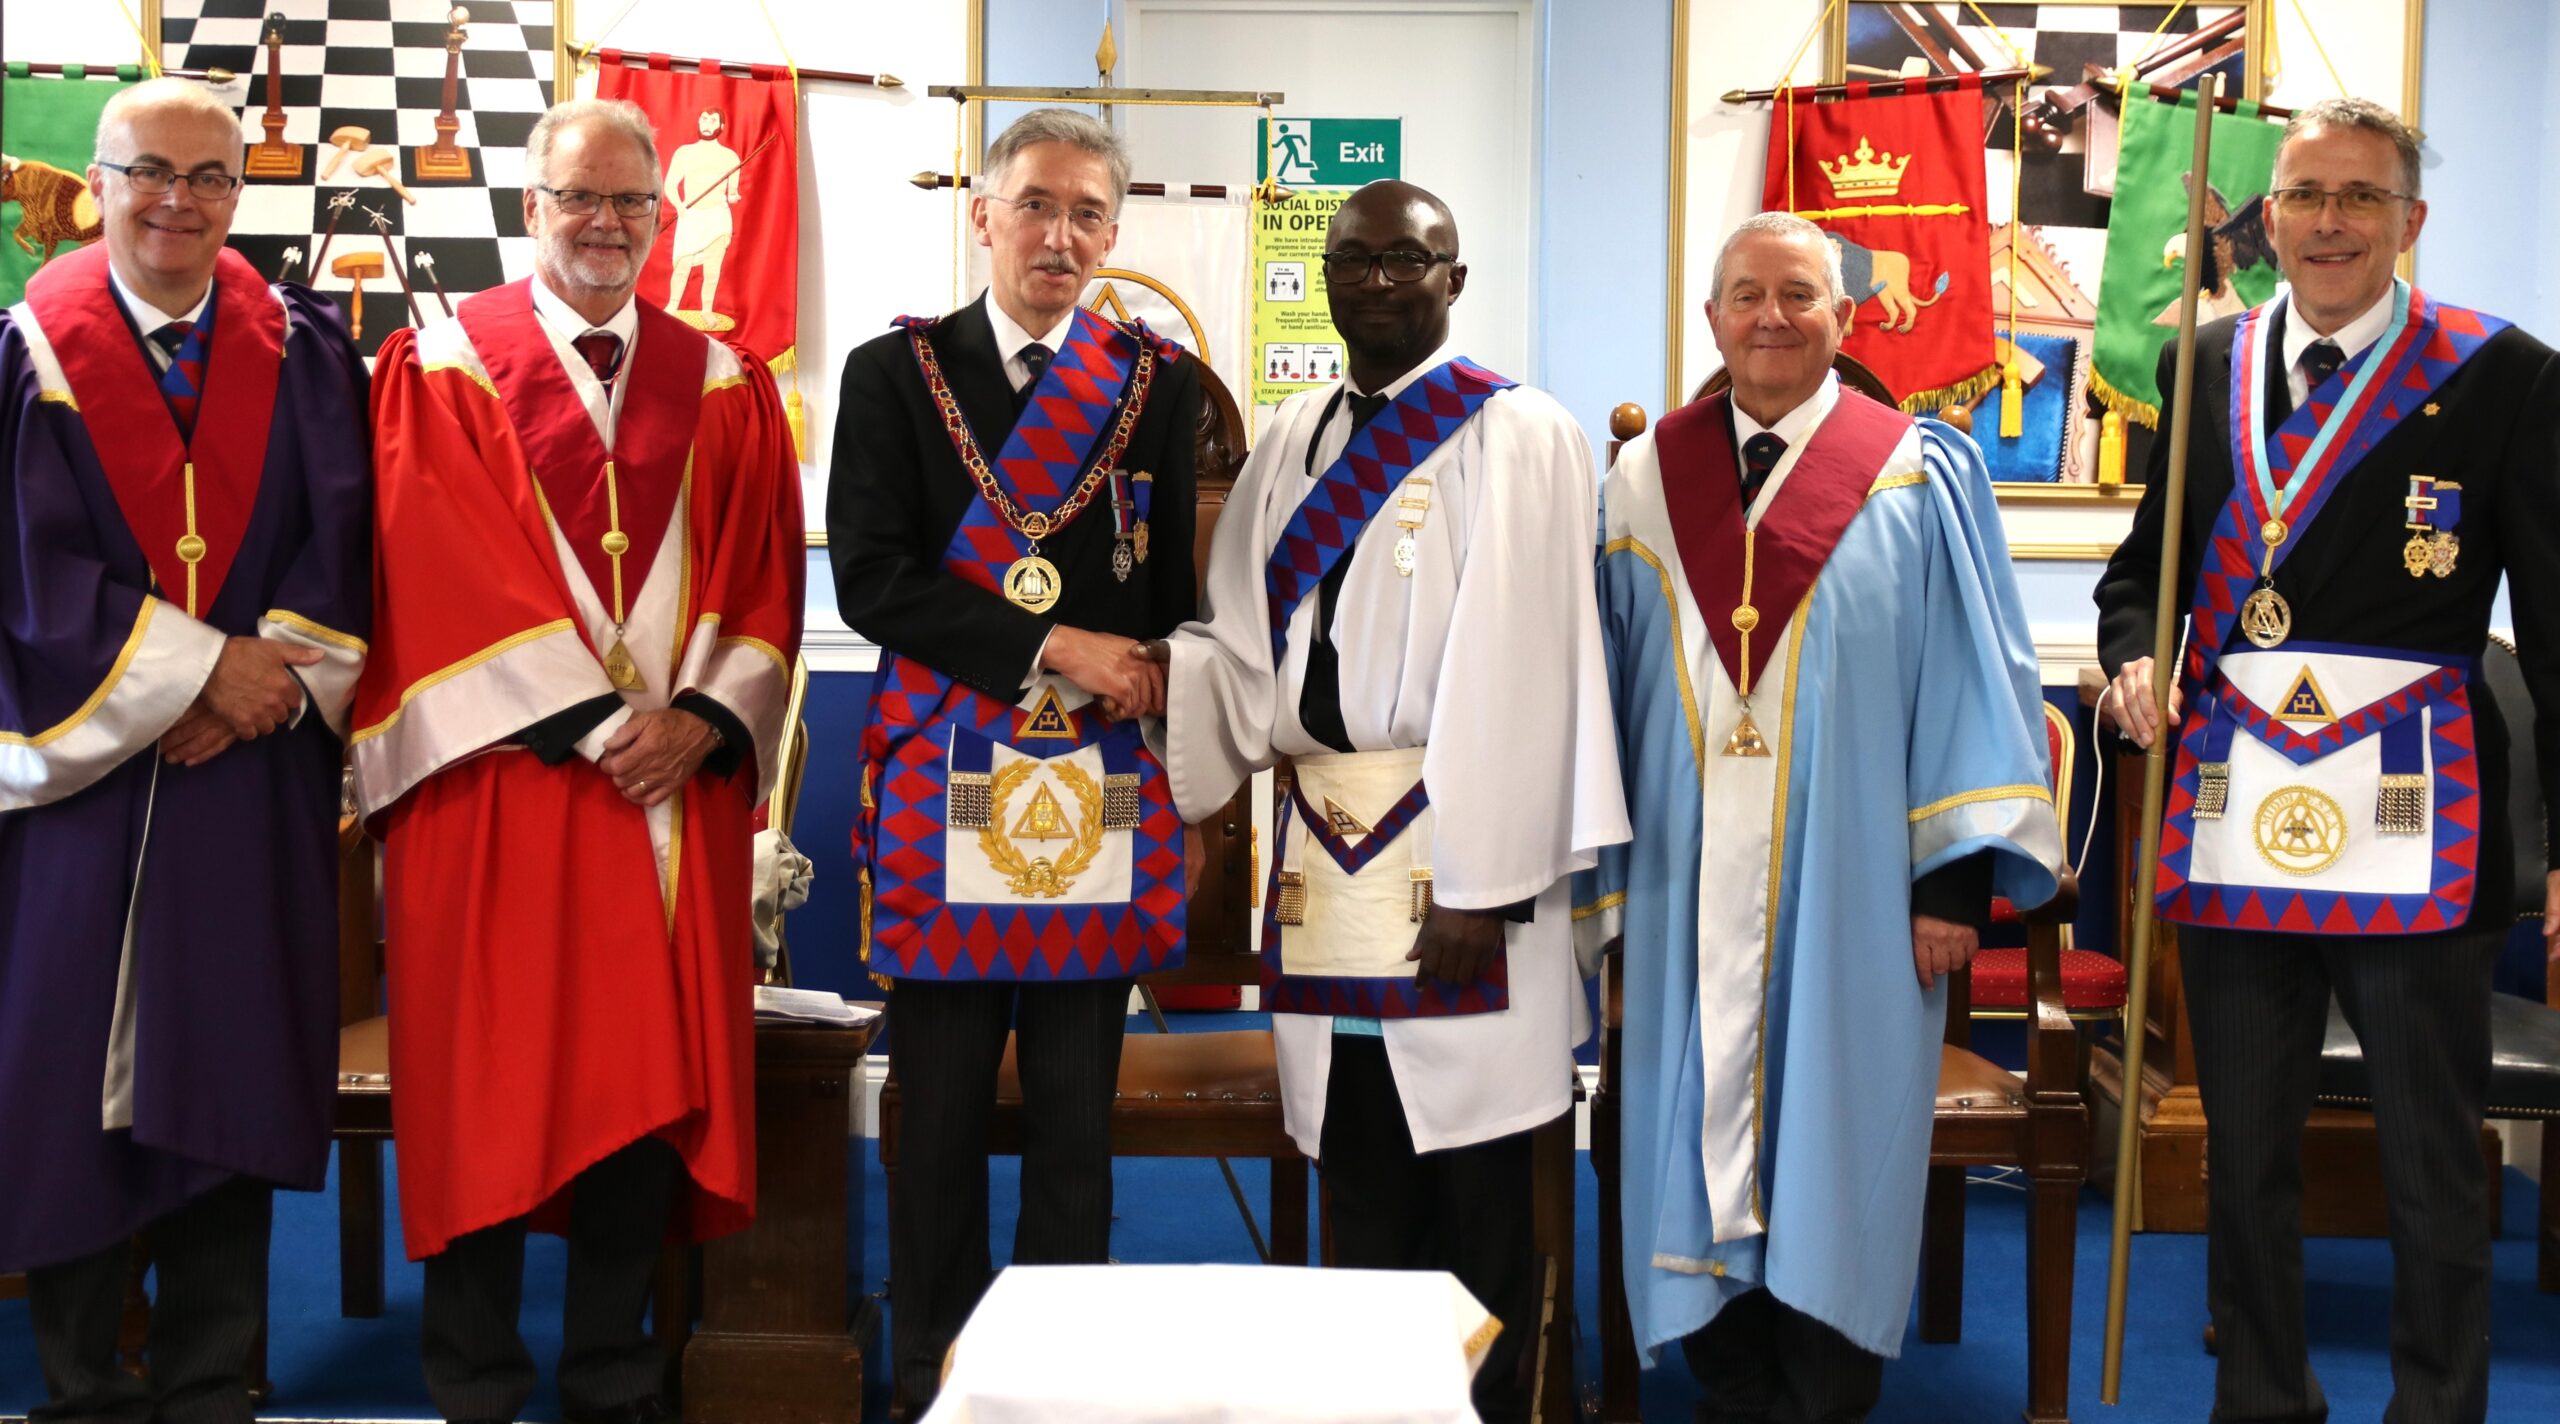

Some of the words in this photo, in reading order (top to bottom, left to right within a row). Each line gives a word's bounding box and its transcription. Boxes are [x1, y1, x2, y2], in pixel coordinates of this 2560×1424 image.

[1340, 142, 1384, 163] Exit
[1263, 199, 1311, 211] SOCIAL
[1263, 214, 1282, 230] IN
[1275, 317, 1305, 325] frequently
